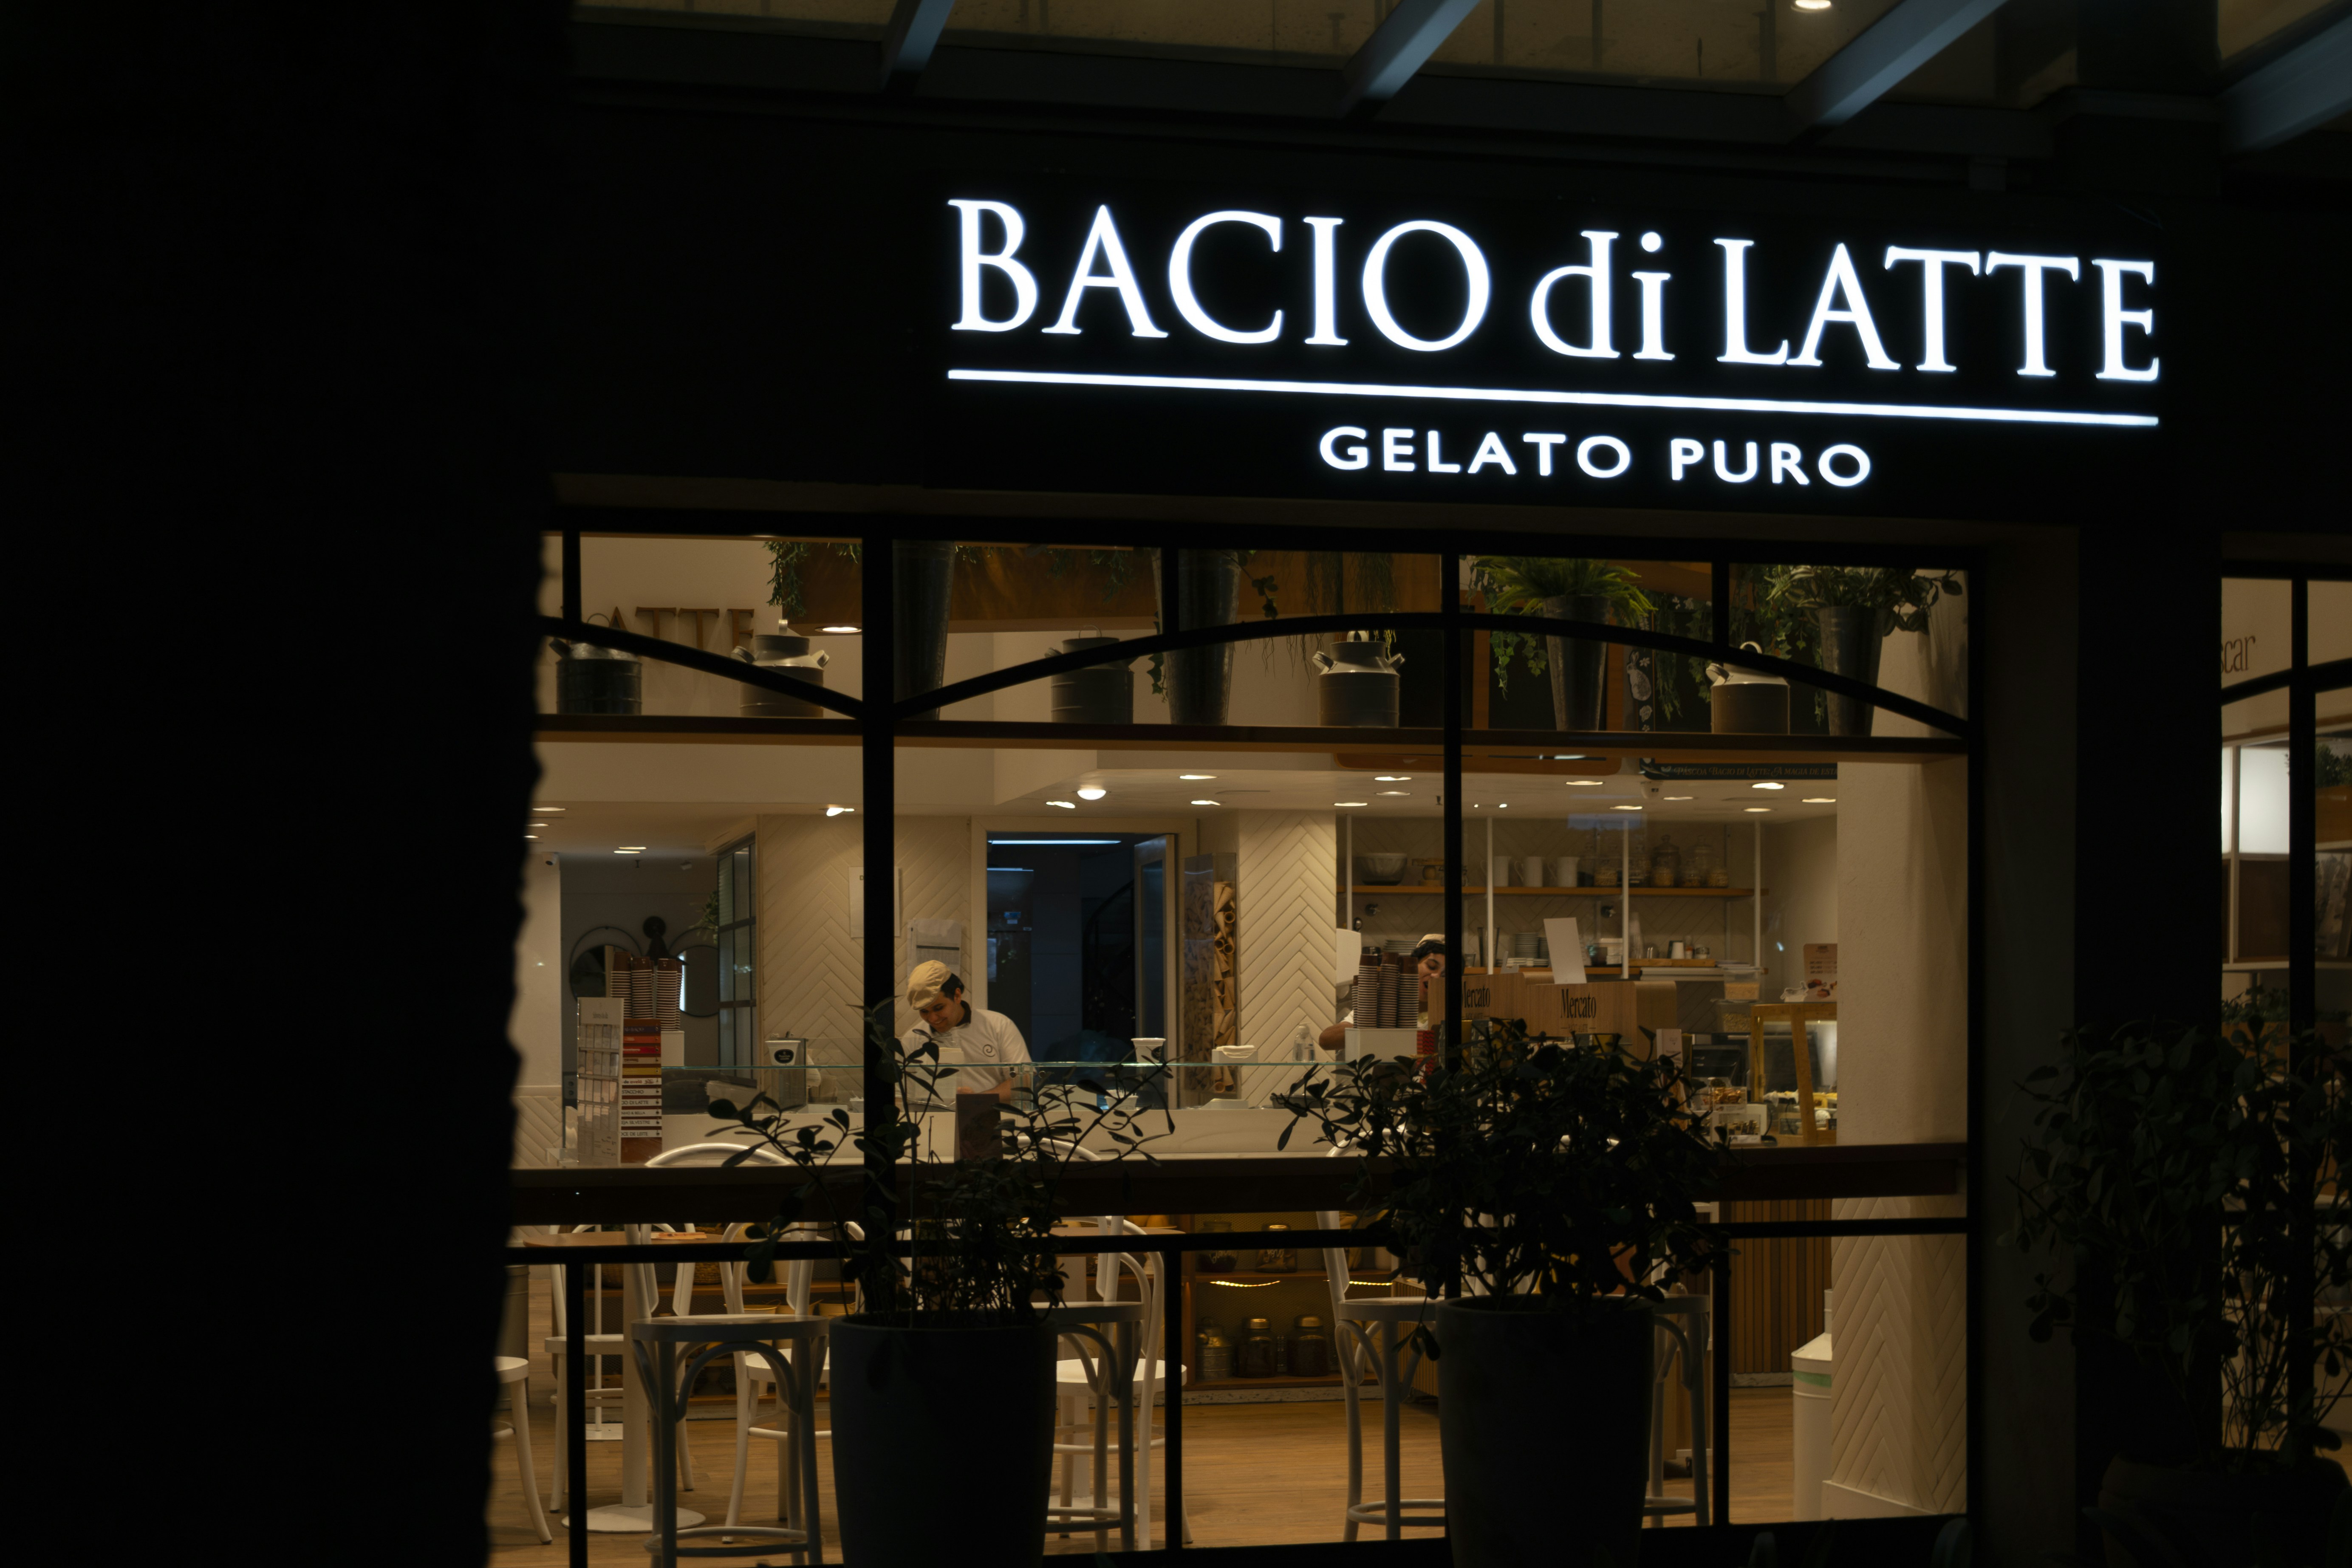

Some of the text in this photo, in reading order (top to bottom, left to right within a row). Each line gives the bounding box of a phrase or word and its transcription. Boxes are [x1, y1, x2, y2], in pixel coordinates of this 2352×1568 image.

[947, 199, 2160, 382] BACIO di LATTE
[1319, 426, 1871, 487] GELATO PURO
[1560, 988, 1597, 1019] Mercato
